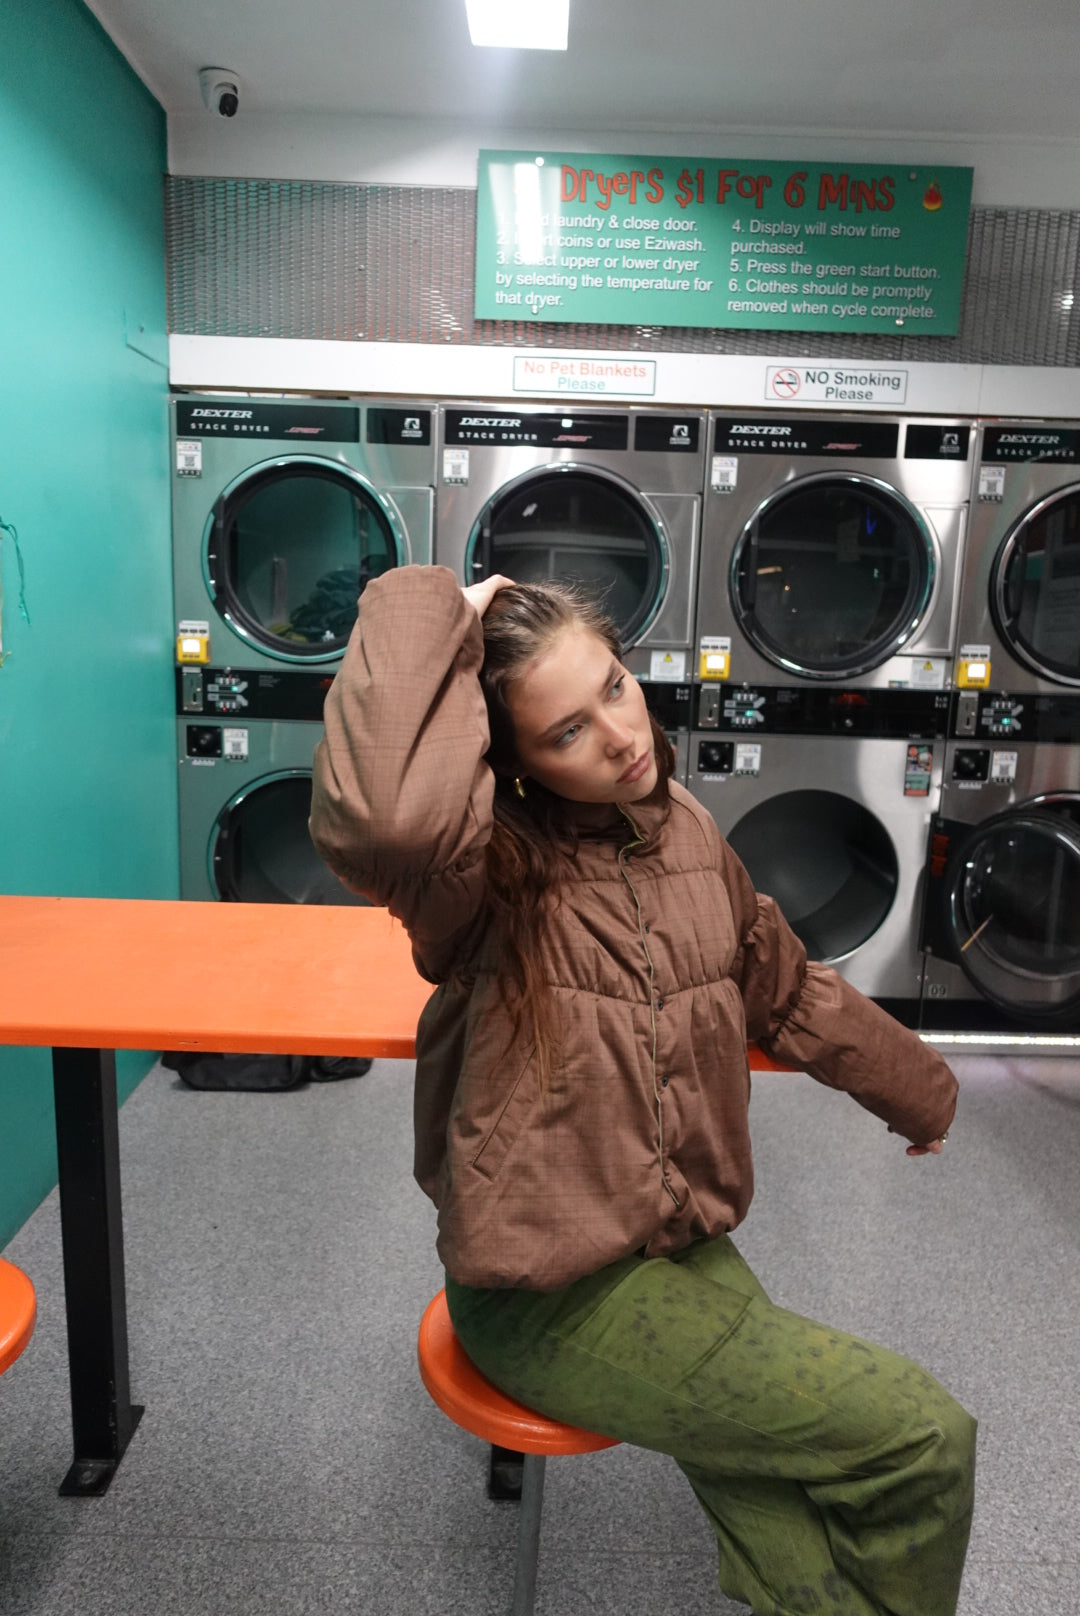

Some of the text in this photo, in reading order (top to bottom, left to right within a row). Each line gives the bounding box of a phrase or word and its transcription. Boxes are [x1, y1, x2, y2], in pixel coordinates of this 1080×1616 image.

[675, 168, 704, 209] $1
[716, 169, 772, 209] For
[784, 172, 807, 208] 6
[554, 214, 605, 231] laundry
[608, 215, 619, 229] &
[622, 216, 660, 231] close
[663, 217, 698, 232] door.
[732, 219, 900, 239] 4. Display will show time
[558, 234, 594, 249] coins
[599, 237, 612, 250] or
[615, 238, 641, 251] use
[645, 238, 706, 252] Eziwash.
[730, 240, 808, 256] purchased.
[496, 251, 700, 274] 3. Sect upper or lower dryer
[729, 259, 942, 280] 5. Press the green start button.
[495, 271, 714, 293] by selecting the temperature for
[728, 278, 933, 302] 6. Clothes should be promptly
[495, 291, 564, 309] that dryer.
[727, 300, 937, 322] removed when cycle complete.
[524, 360, 647, 378] No Pet Blankets
[557, 377, 606, 391] Please
[805, 371, 901, 391] NO Smoking
[825, 387, 873, 401] Please
[191, 408, 253, 419] DEXTER
[459, 417, 522, 428] DEXTER
[190, 422, 270, 433] STACK DRYER
[458, 431, 538, 441] STACK DRYER
[729, 425, 792, 436] DEXTER
[728, 439, 808, 449] STACK DRYER
[998, 434, 1060, 444] DEXTER
[996, 448, 1032, 456] STACK
